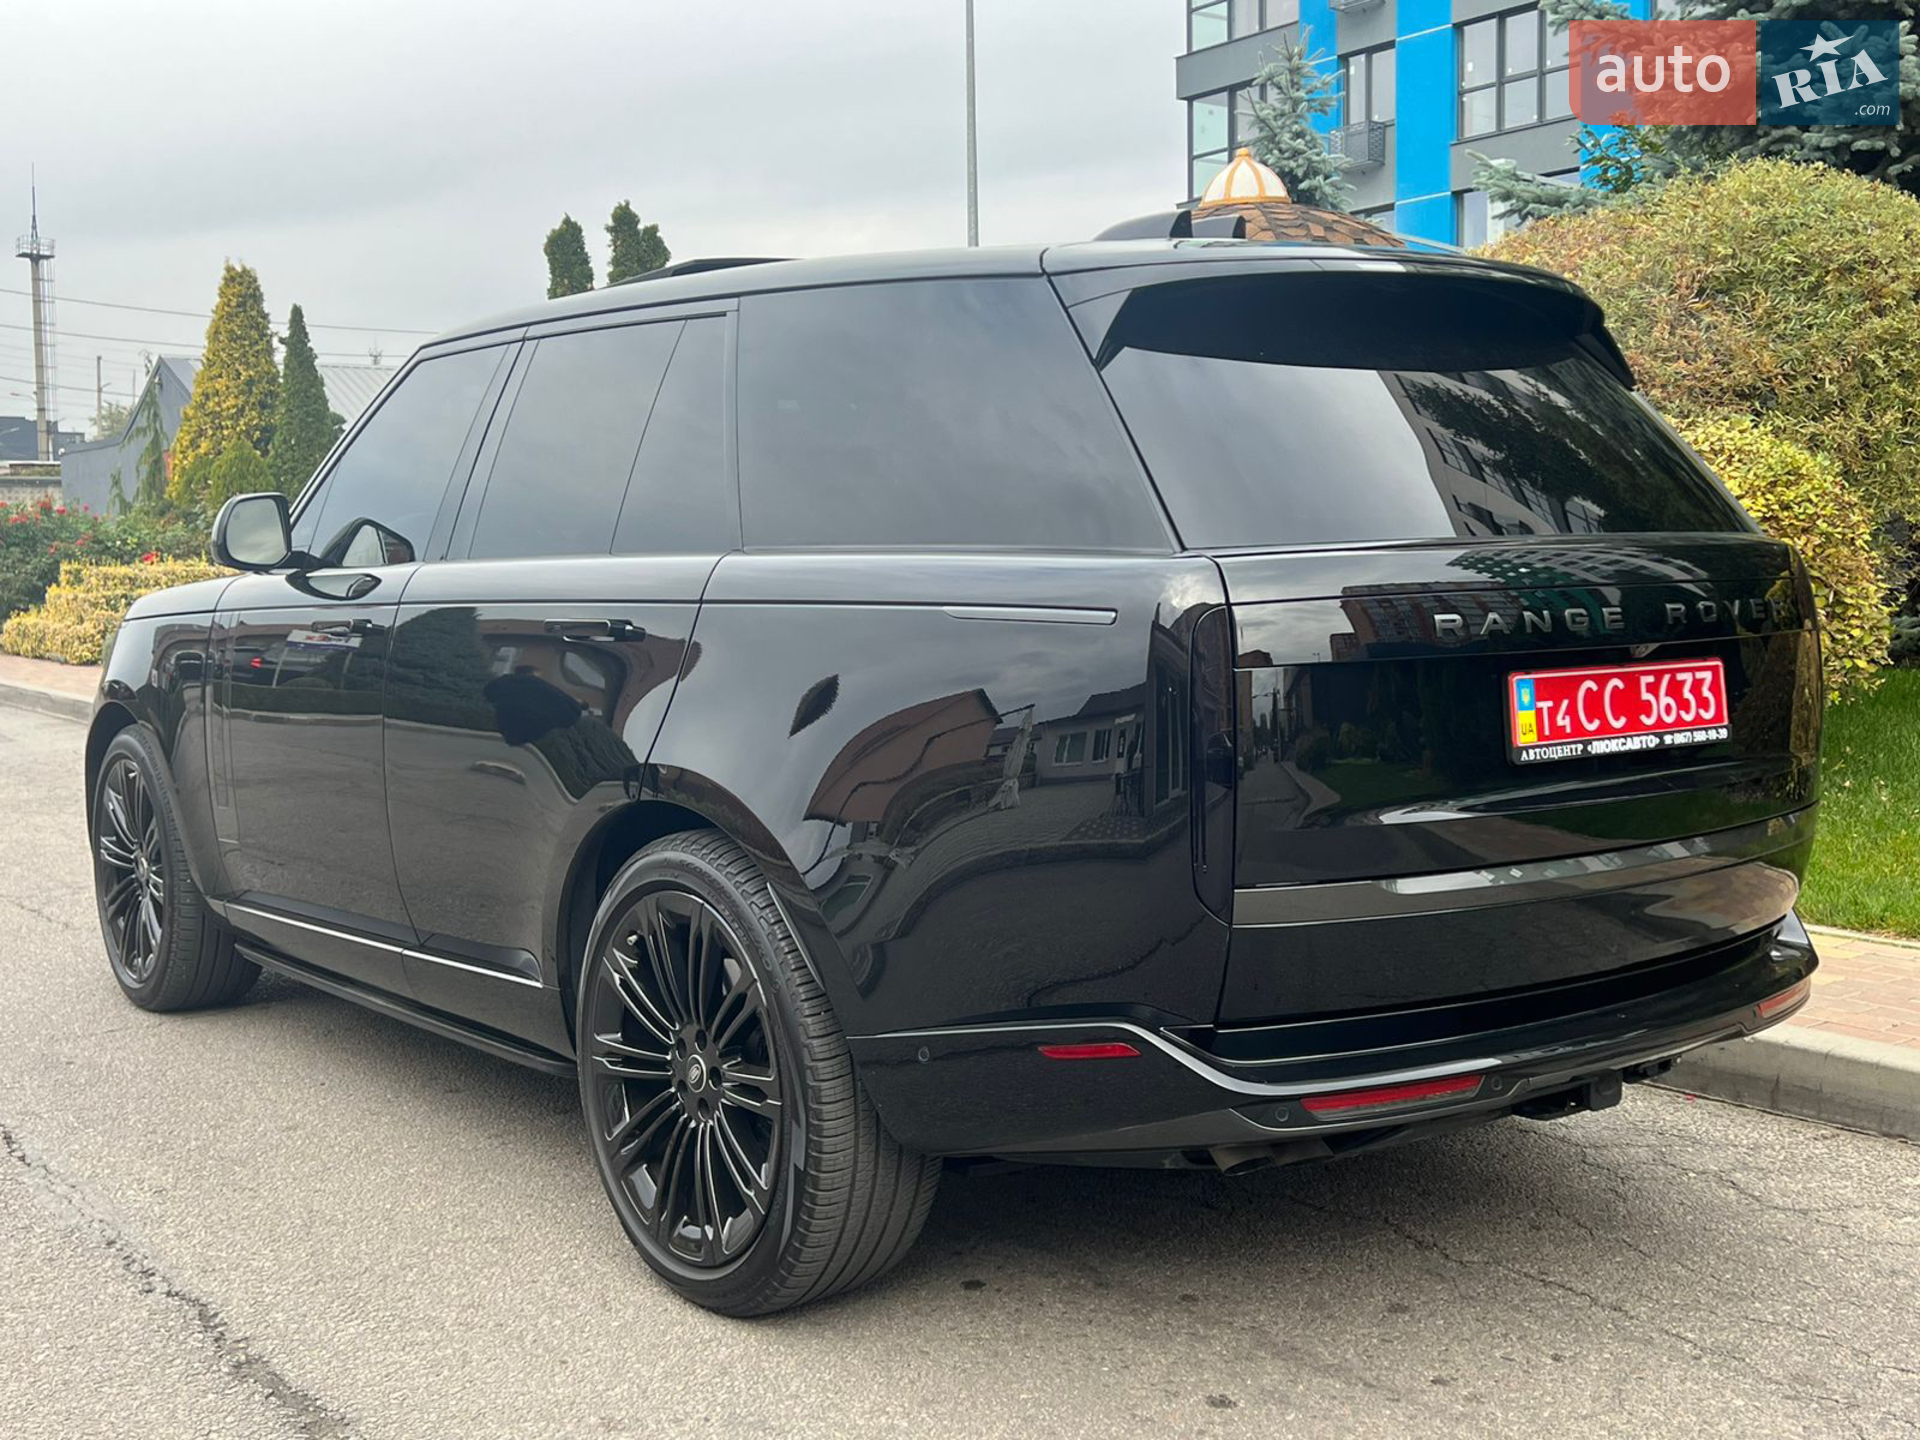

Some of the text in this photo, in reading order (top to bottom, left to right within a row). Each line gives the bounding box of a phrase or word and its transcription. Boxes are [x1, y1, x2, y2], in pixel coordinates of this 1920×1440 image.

[1432, 596, 1791, 637] RANGE ROVER
[1639, 669, 1717, 727] 5633
[1521, 723, 1535, 737] UA
[1520, 743, 1584, 762] АВТОЦЕНТР
